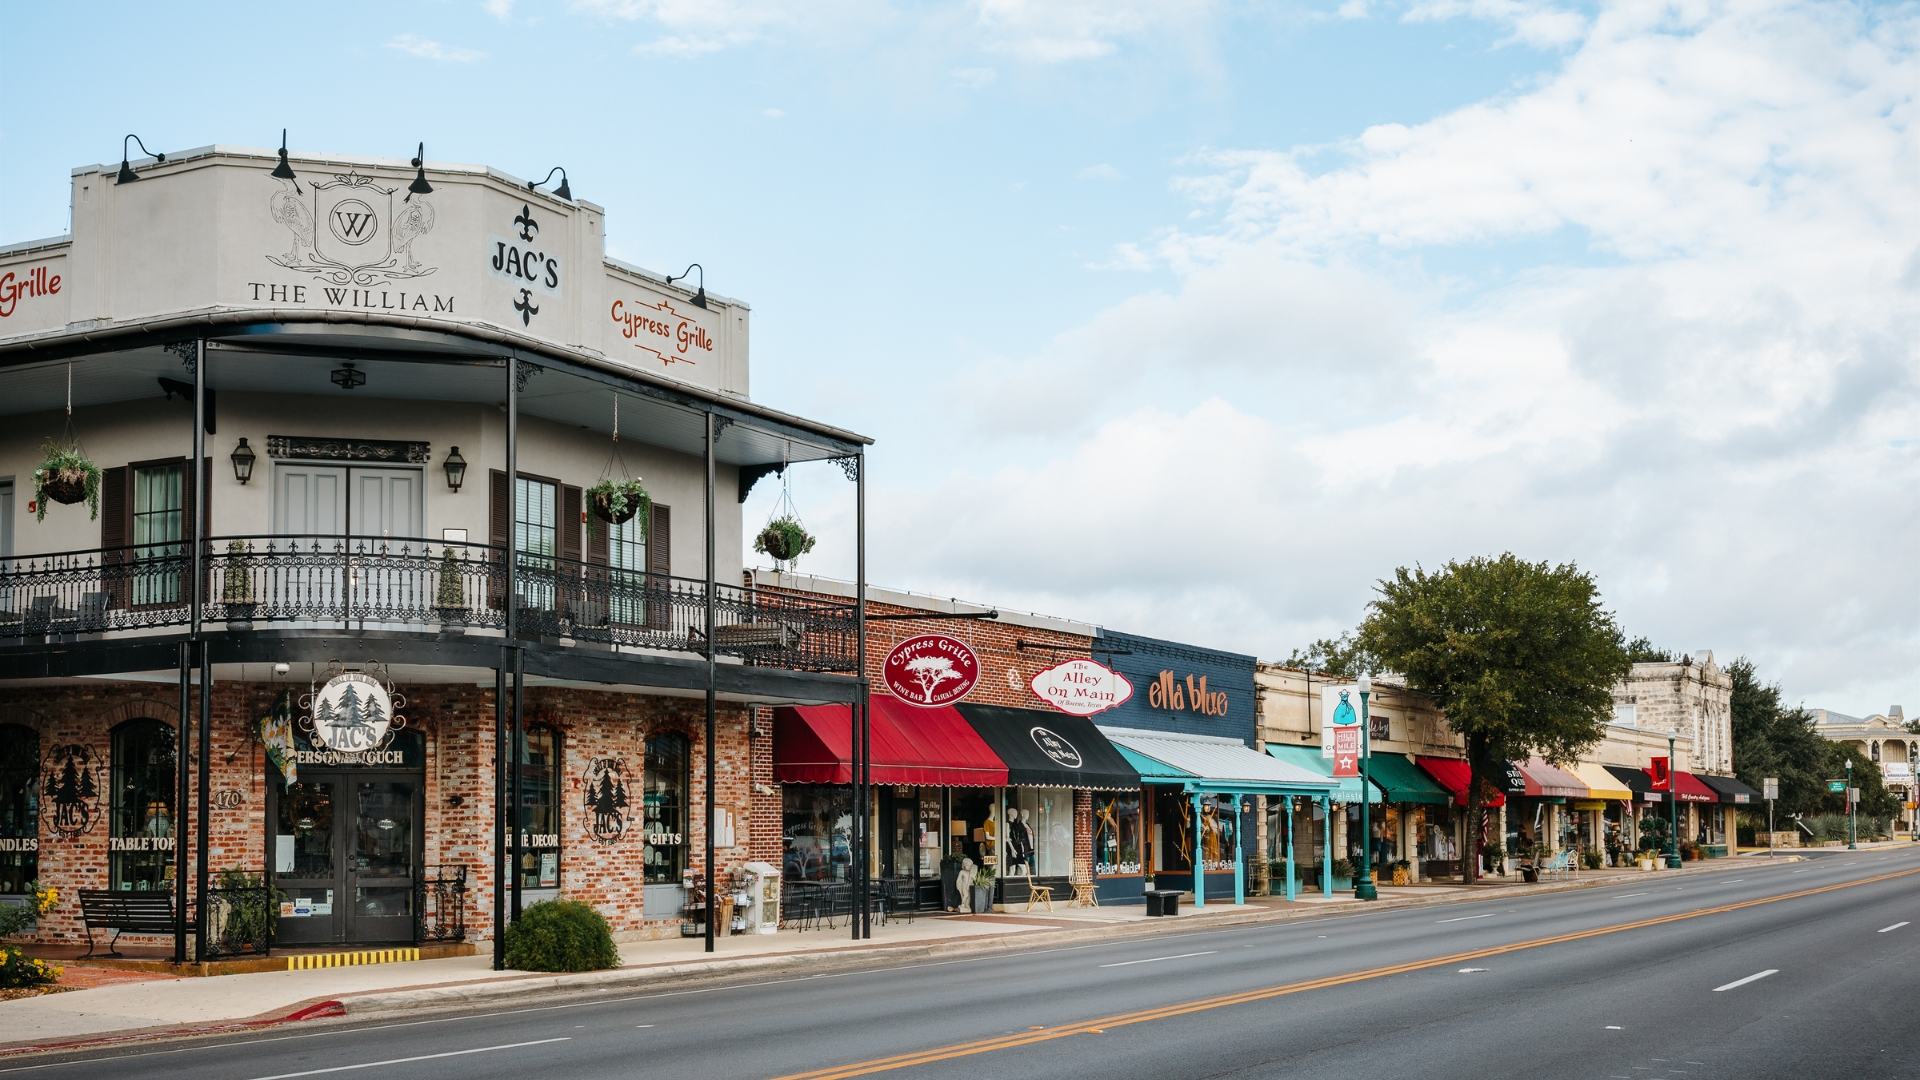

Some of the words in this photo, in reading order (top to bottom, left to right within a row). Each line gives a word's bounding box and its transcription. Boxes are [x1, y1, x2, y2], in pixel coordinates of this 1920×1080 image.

[336, 211, 373, 238] W
[492, 241, 558, 289] JAC'S
[0, 266, 62, 318] Grille
[248, 282, 307, 304] THE
[323, 287, 456, 314] WILLIAM
[611, 300, 670, 339] Cypress
[676, 321, 713, 354] Grille
[890, 640, 934, 666] Cypress
[938, 639, 972, 668] Grille
[1063, 672, 1102, 686] Alley
[893, 680, 909, 696] WINE
[909, 692, 923, 702] BAR
[933, 692, 953, 702] CASUAL
[953, 679, 970, 696] DINING
[1048, 686, 1068, 698] On
[1073, 688, 1115, 702] Main
[1149, 670, 1184, 710] ella
[1186, 674, 1228, 717] blue
[328, 726, 377, 748] JAC'S
[1042, 737, 1061, 748] Alley
[217, 792, 239, 806] 170
[929, 801, 940, 810] Alley
[1332, 791, 1363, 800] celeste
[53, 802, 89, 826] JAC'S
[594, 812, 622, 834] JAC'S
[532, 834, 558, 846] DECOR
[650, 833, 682, 845] GIFTS
[784, 822, 807, 837] Cypress
[0, 838, 38, 851] NDLES
[110, 838, 149, 851] TABLE
[151, 838, 175, 851] TOP
